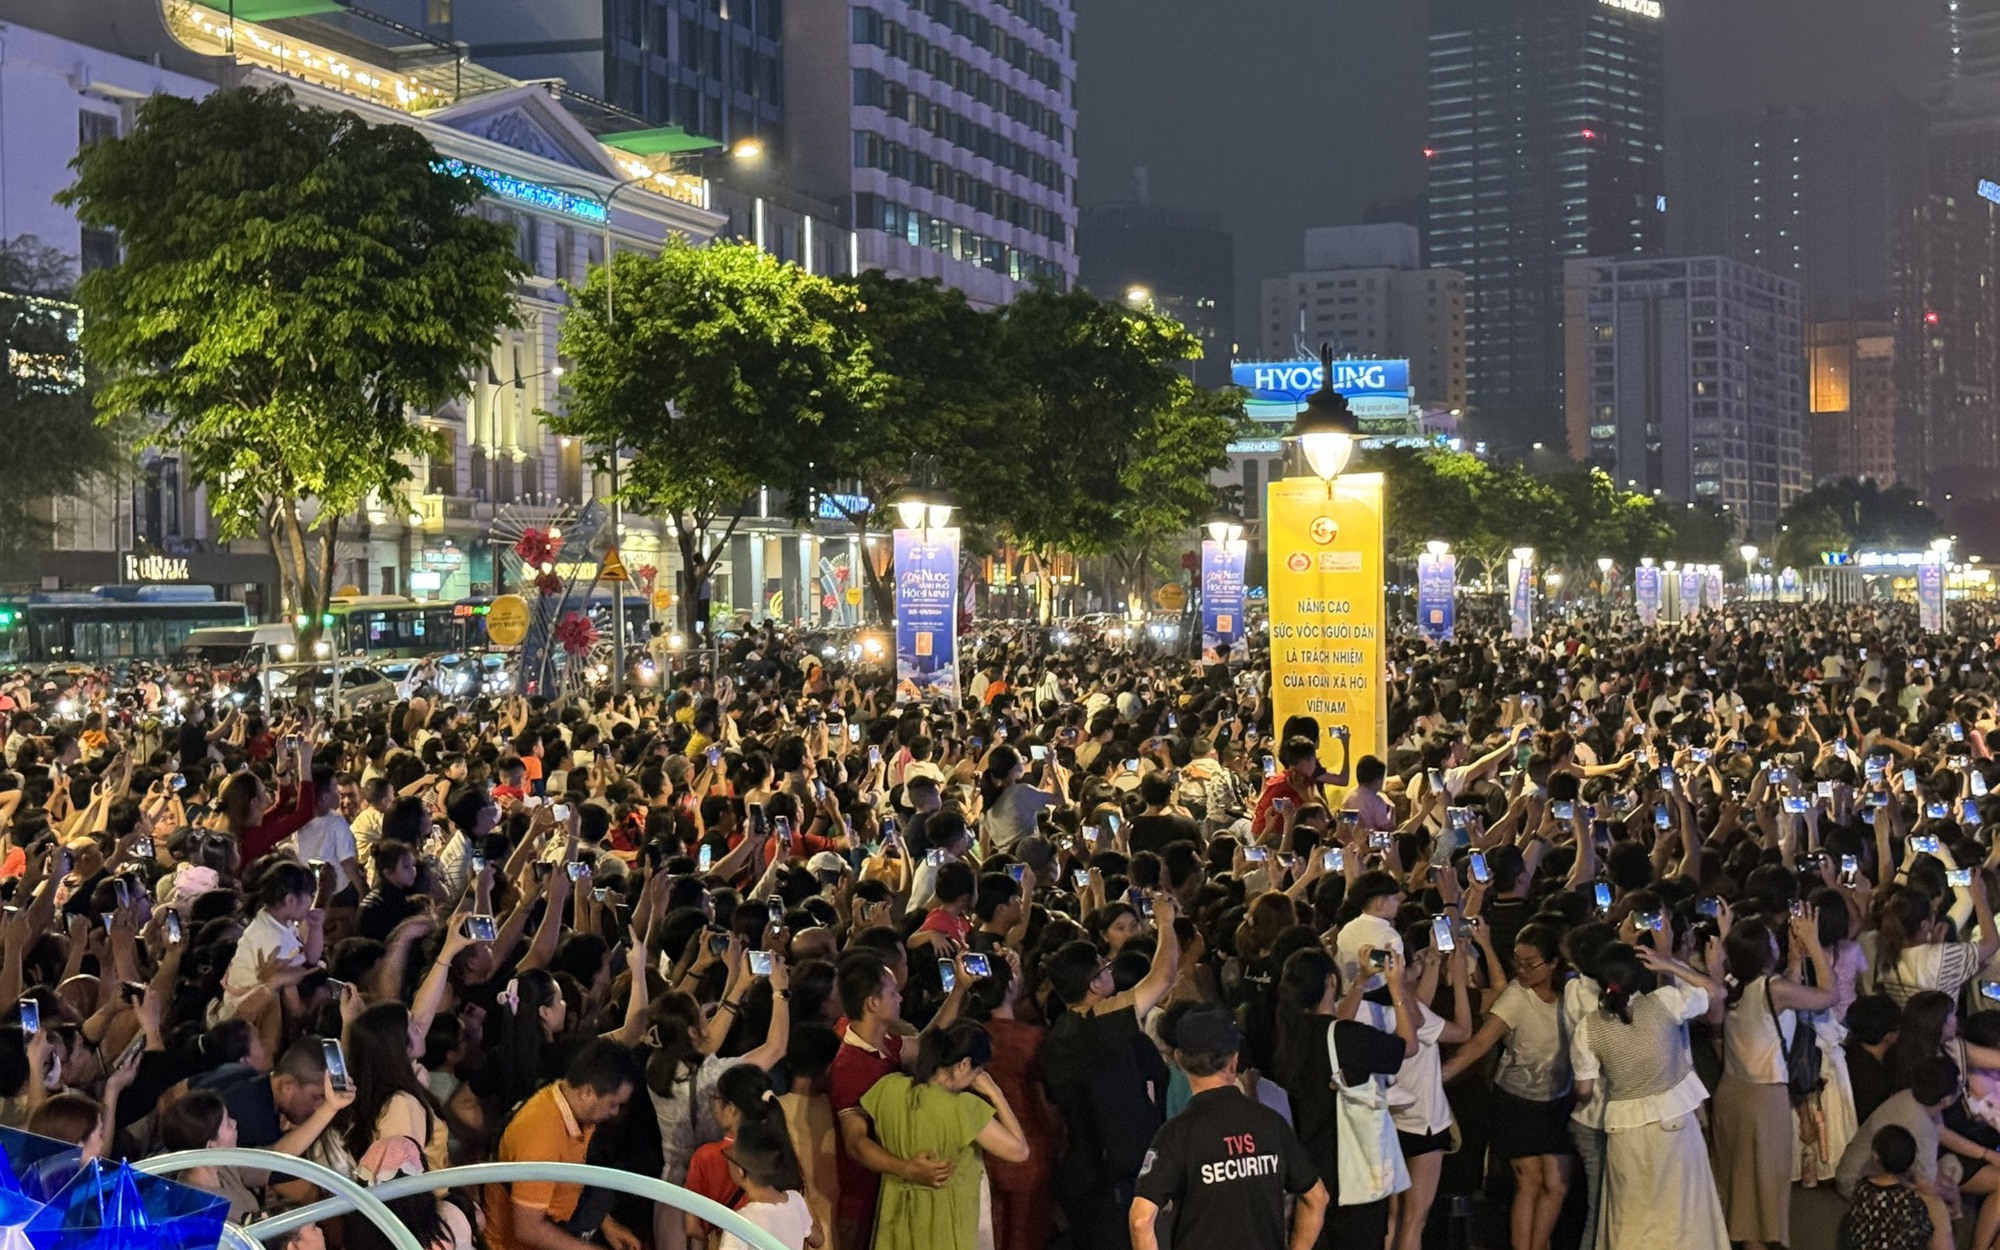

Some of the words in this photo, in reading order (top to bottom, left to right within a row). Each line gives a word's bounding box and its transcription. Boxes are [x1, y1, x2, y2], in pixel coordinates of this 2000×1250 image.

[1298, 597, 1325, 613] NÂNG
[1327, 600, 1350, 613] CAO
[1273, 622, 1293, 639] SỨC
[1296, 622, 1319, 638] VÓC
[1354, 622, 1374, 639] DÂN
[1286, 647, 1298, 663] LÀ
[1301, 647, 1329, 663] TRÁCH
[1333, 648, 1363, 668] NHIỆM
[1283, 671, 1305, 688] CỦA
[1333, 673, 1347, 689] XÃ
[1350, 673, 1367, 693] HỘI
[1307, 697, 1323, 716] VIỆT
[1324, 701, 1346, 713] NAM
[1223, 1134, 1255, 1155] TVS
[1201, 1154, 1278, 1185] SECURITY
